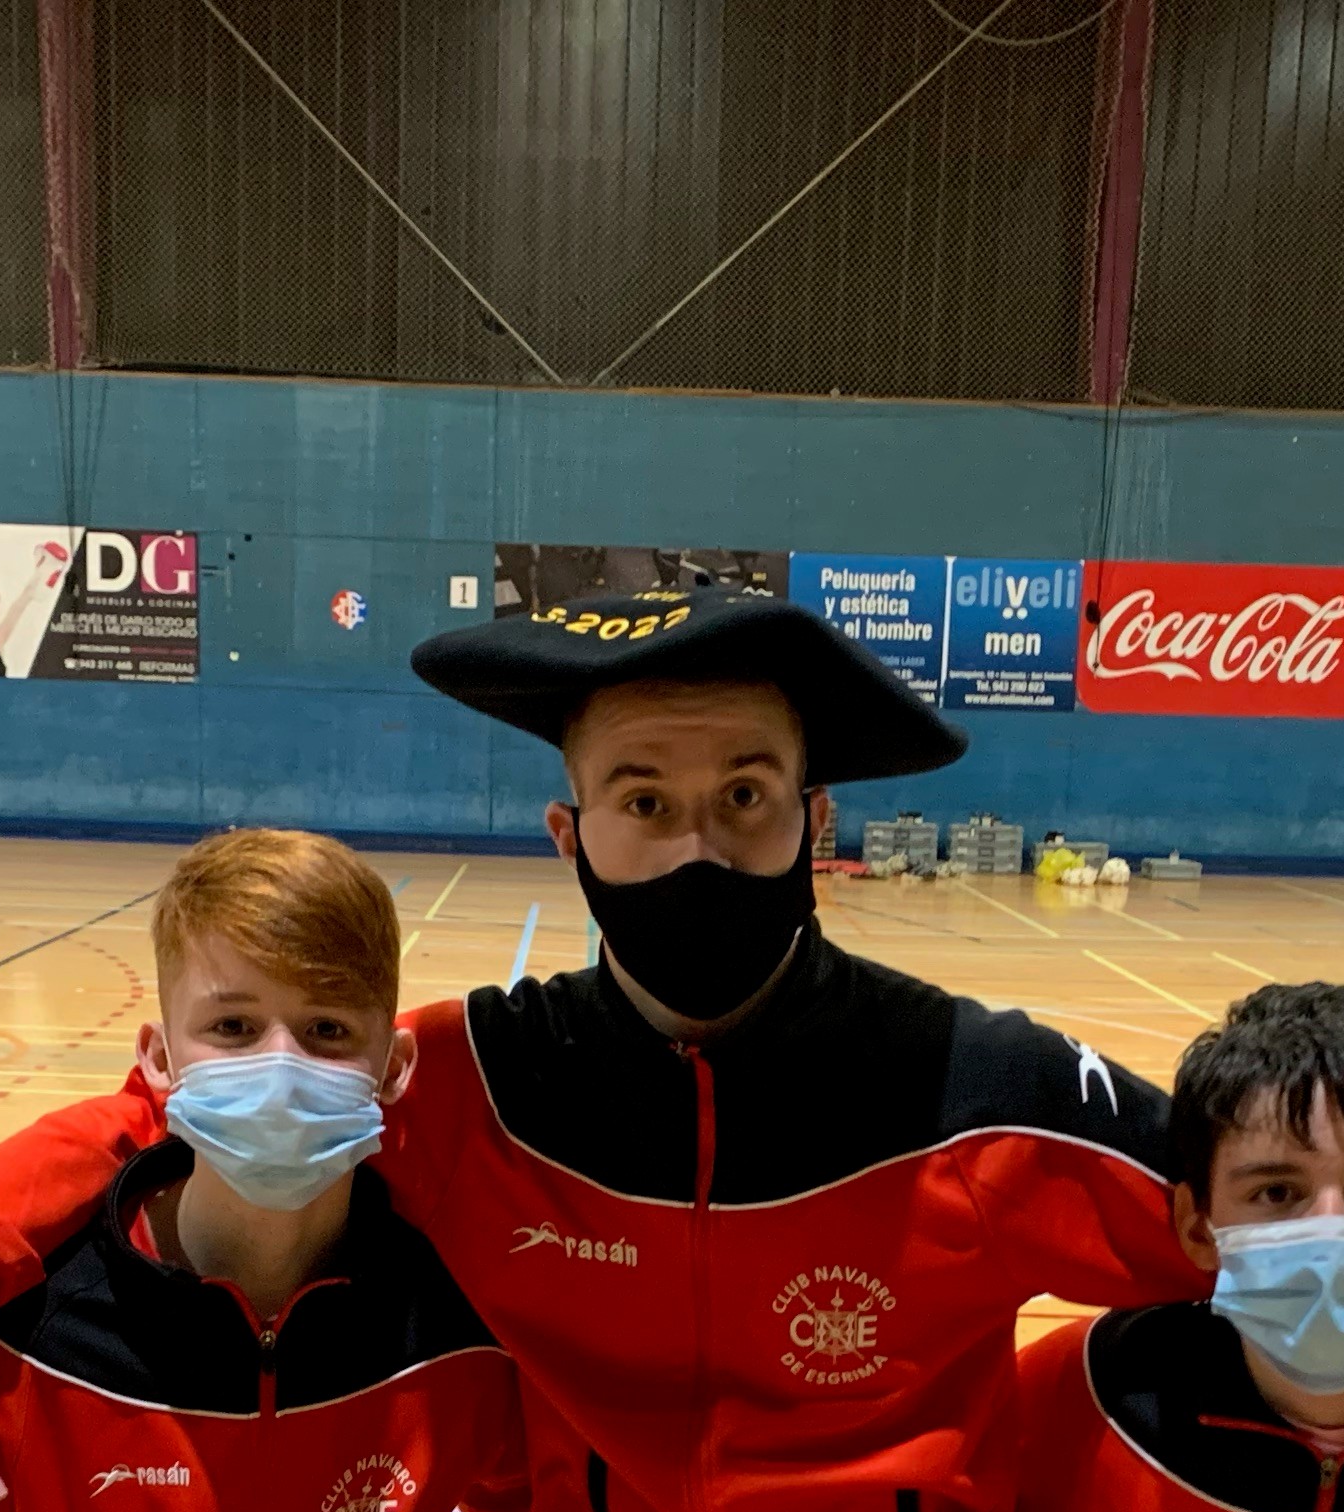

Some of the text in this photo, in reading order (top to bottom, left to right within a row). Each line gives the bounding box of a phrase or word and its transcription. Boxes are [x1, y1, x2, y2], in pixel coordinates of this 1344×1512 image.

[86, 532, 195, 594] DG
[821, 567, 916, 594] Peluquería
[825, 592, 909, 619] y estética
[866, 618, 933, 641] hombre
[984, 632, 1041, 656] men
[772, 1265, 896, 1314] CLUB NAVARRO
[780, 1352, 888, 1385] DE ESGRIMA
[321, 1453, 416, 1512] CLUB NAVARRO
